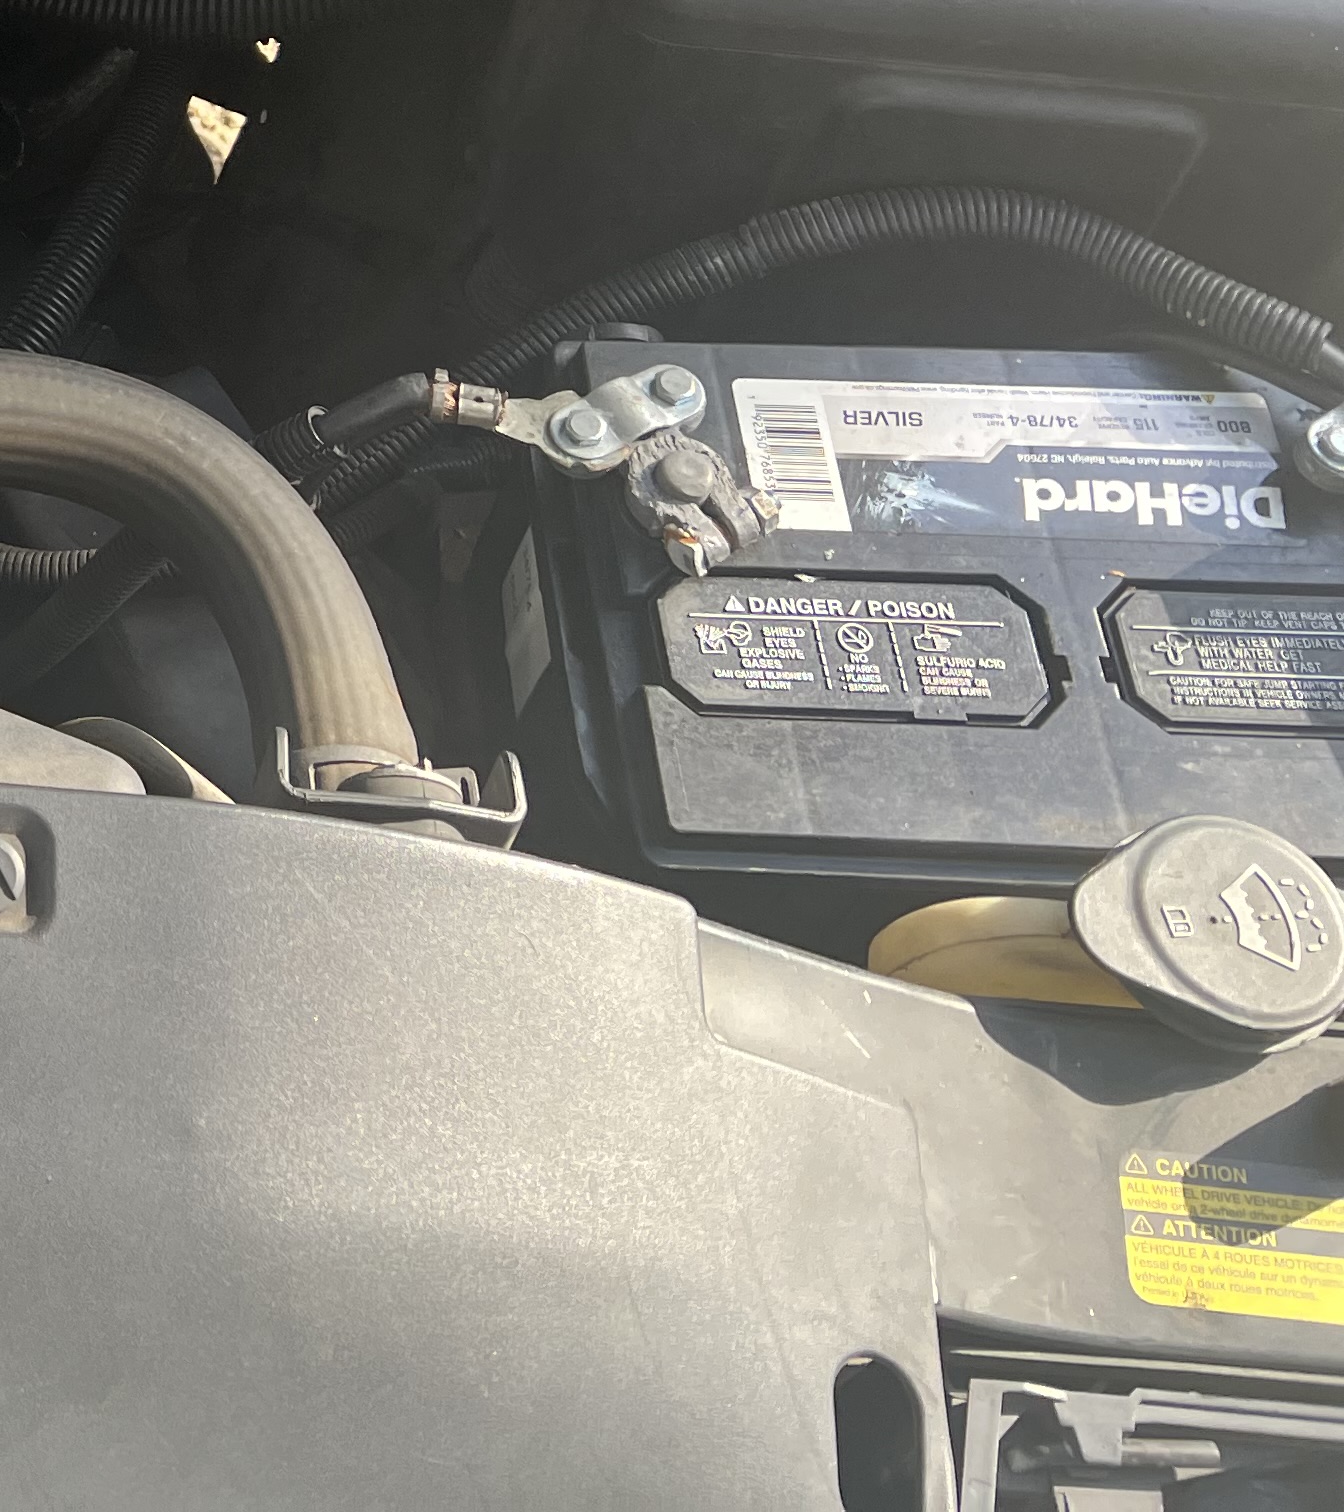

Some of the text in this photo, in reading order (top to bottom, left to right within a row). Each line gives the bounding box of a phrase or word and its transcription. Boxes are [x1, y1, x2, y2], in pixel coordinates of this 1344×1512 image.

[843, 409, 924, 427] SILVER
[1007, 414, 1079, 429] 34/78-4
[1133, 418, 1159, 431] 115
[1217, 420, 1252, 434] 800
[1051, 454, 1065, 464] NC
[1137, 456, 1160, 467] Auto
[1162, 457, 1204, 468] Advance
[747, 596, 956, 620] DANGER / POISON
[1209, 609, 1234, 618] KEEP
[1238, 609, 1257, 619] OUT
[1261, 610, 1274, 619] OF
[1278, 610, 1298, 620] THE
[1300, 611, 1332, 621] REACH
[1190, 617, 1338, 631] DO NOT TIP KEEP VENT CAPS
[762, 625, 806, 638] SHIELD
[763, 637, 797, 648] EYES
[1193, 634, 1232, 648] FLUSH
[1236, 636, 1268, 649] EYES
[738, 648, 805, 660] EXPLOSIVE
[849, 653, 869, 664] NO
[1196, 646, 1304, 661] WITH WATER GET
[741, 658, 783, 669] GASES
[916, 655, 1006, 670] SULFURIC ACID
[1200, 658, 1322, 674] MEDICAL HELP FAST
[714, 669, 734, 678] CAN
[734, 670, 765, 680] CAUSE
[919, 667, 973, 678] CAN CAUSE
[745, 679, 792, 690] OR INJURY
[974, 678, 989, 688] OR
[1214, 676, 1235, 687] FOR
[1237, 677, 1260, 688] SAFE
[1263, 678, 1288, 689] JUMP
[1290, 679, 1337, 690] STARTING
[1171, 686, 1241, 698] INSTRUCTIONS
[1242, 688, 1253, 698] IN
[1255, 688, 1293, 699] VEHICLE
[1172, 696, 1181, 705] IF
[1185, 697, 1205, 706] NOT
[1207, 697, 1256, 708] AVAILABLE
[1257, 699, 1282, 709] SEEK
[1284, 700, 1323, 710] SERVICE
[1155, 1158, 1248, 1184] CAUTION
[1126, 1181, 1149, 1194] ALL
[1152, 1183, 1200, 1201] WHEEL
[1201, 1189, 1241, 1204] DRIVE
[1127, 1196, 1168, 1210] vehicle
[1200, 1203, 1246, 1218] 2-wheel
[1249, 1209, 1278, 1222] drive
[1162, 1218, 1277, 1248] ATTENTION
[1132, 1240, 1197, 1259] VÉHICULE
[1213, 1250, 1220, 1261] 4
[1224, 1251, 1271, 1267] ROUES
[1173, 1261, 1187, 1272] de
[1191, 1264, 1205, 1274] ce
[1260, 1272, 1278, 1282] sur
[1281, 1274, 1297, 1284] un
[1198, 1279, 1226, 1290] deux
[1229, 1283, 1262, 1295] roues
